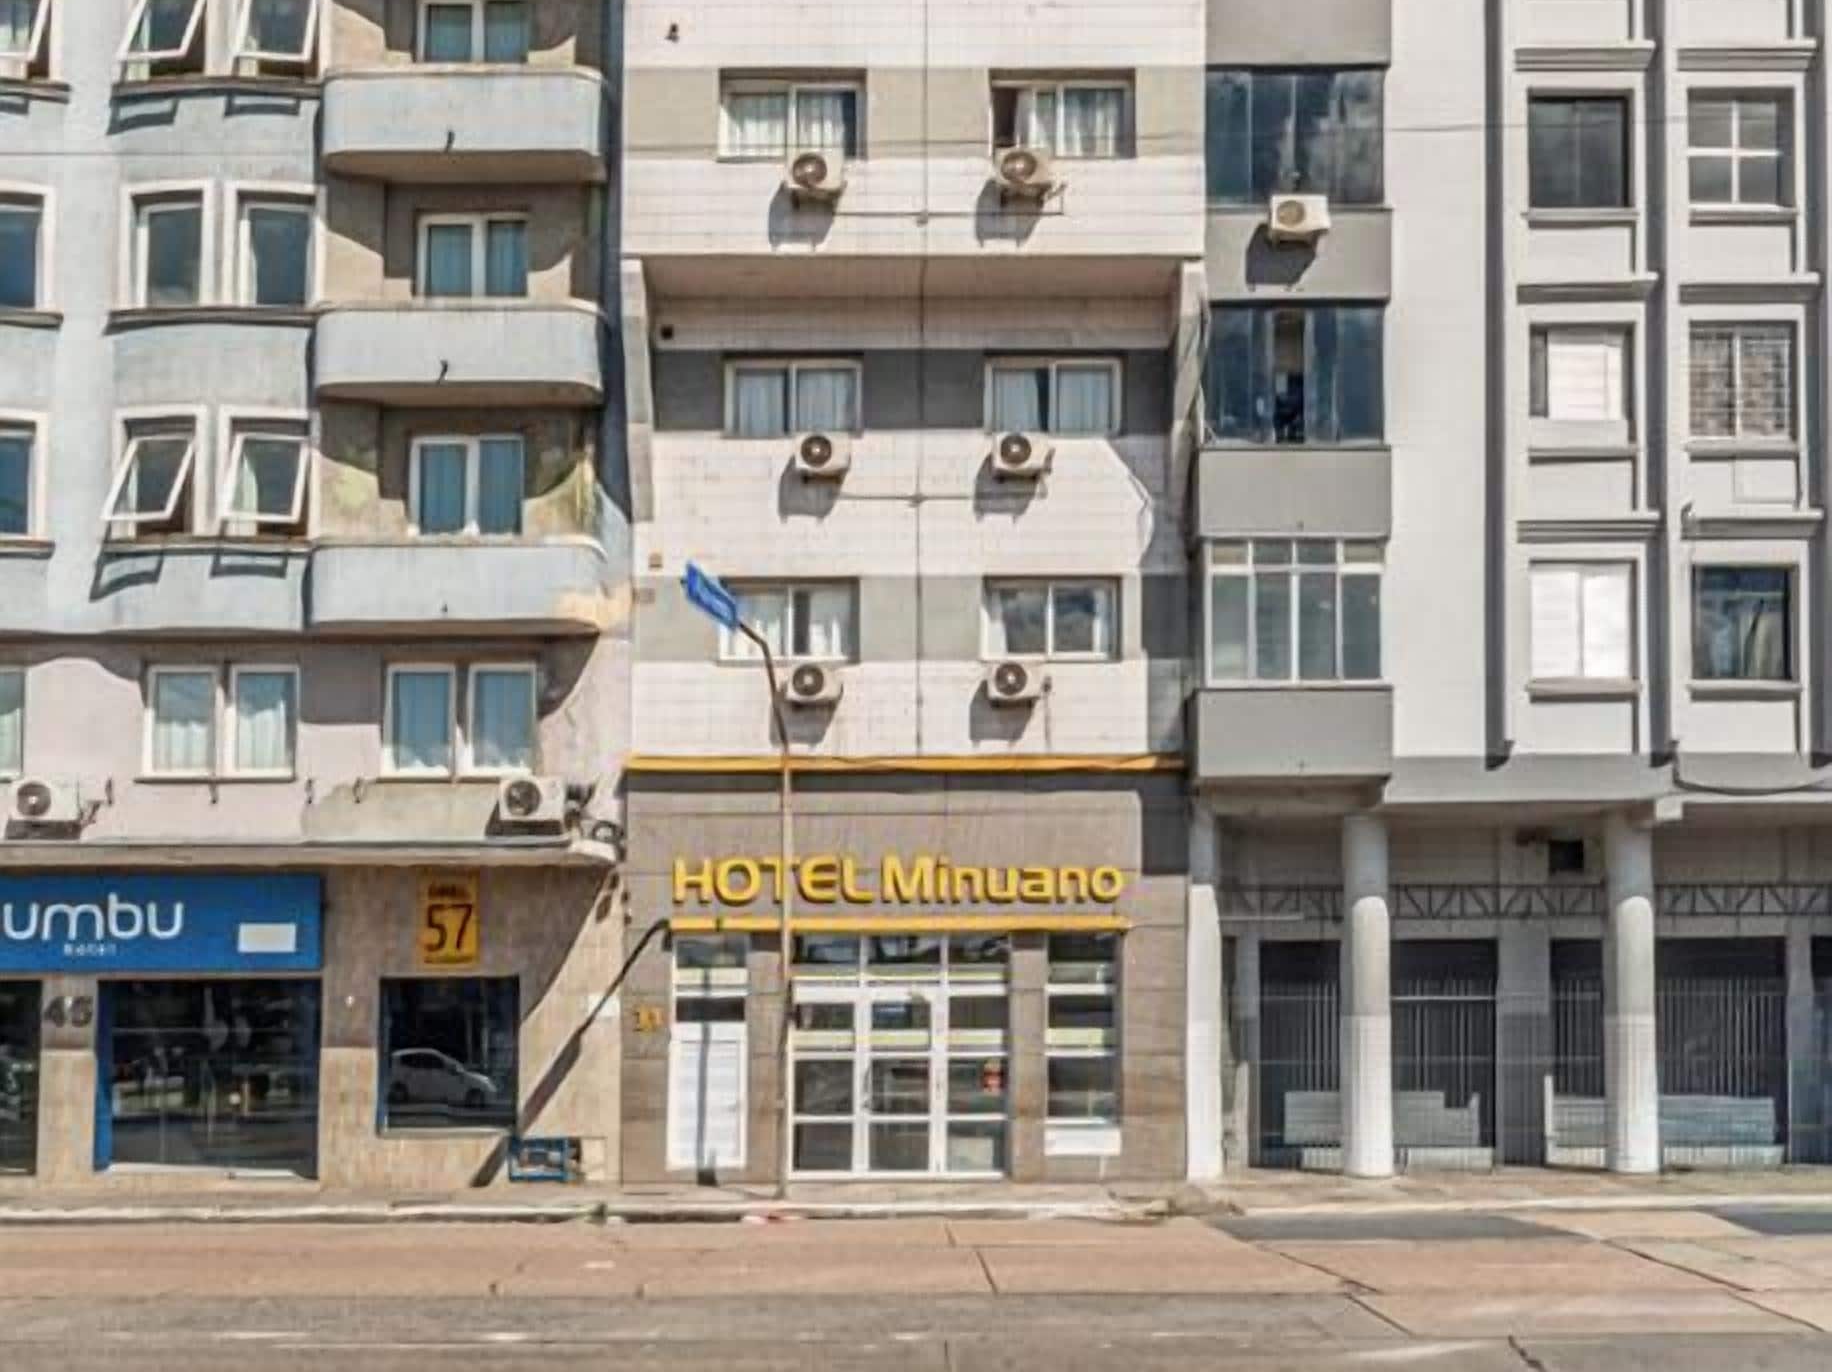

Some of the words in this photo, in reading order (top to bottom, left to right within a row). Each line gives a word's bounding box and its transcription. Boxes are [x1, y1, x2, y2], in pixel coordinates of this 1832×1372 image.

[672, 854, 875, 904] HOTEL
[880, 854, 1125, 904] Minuano
[3, 892, 184, 941] umbu
[424, 902, 473, 952] 57
